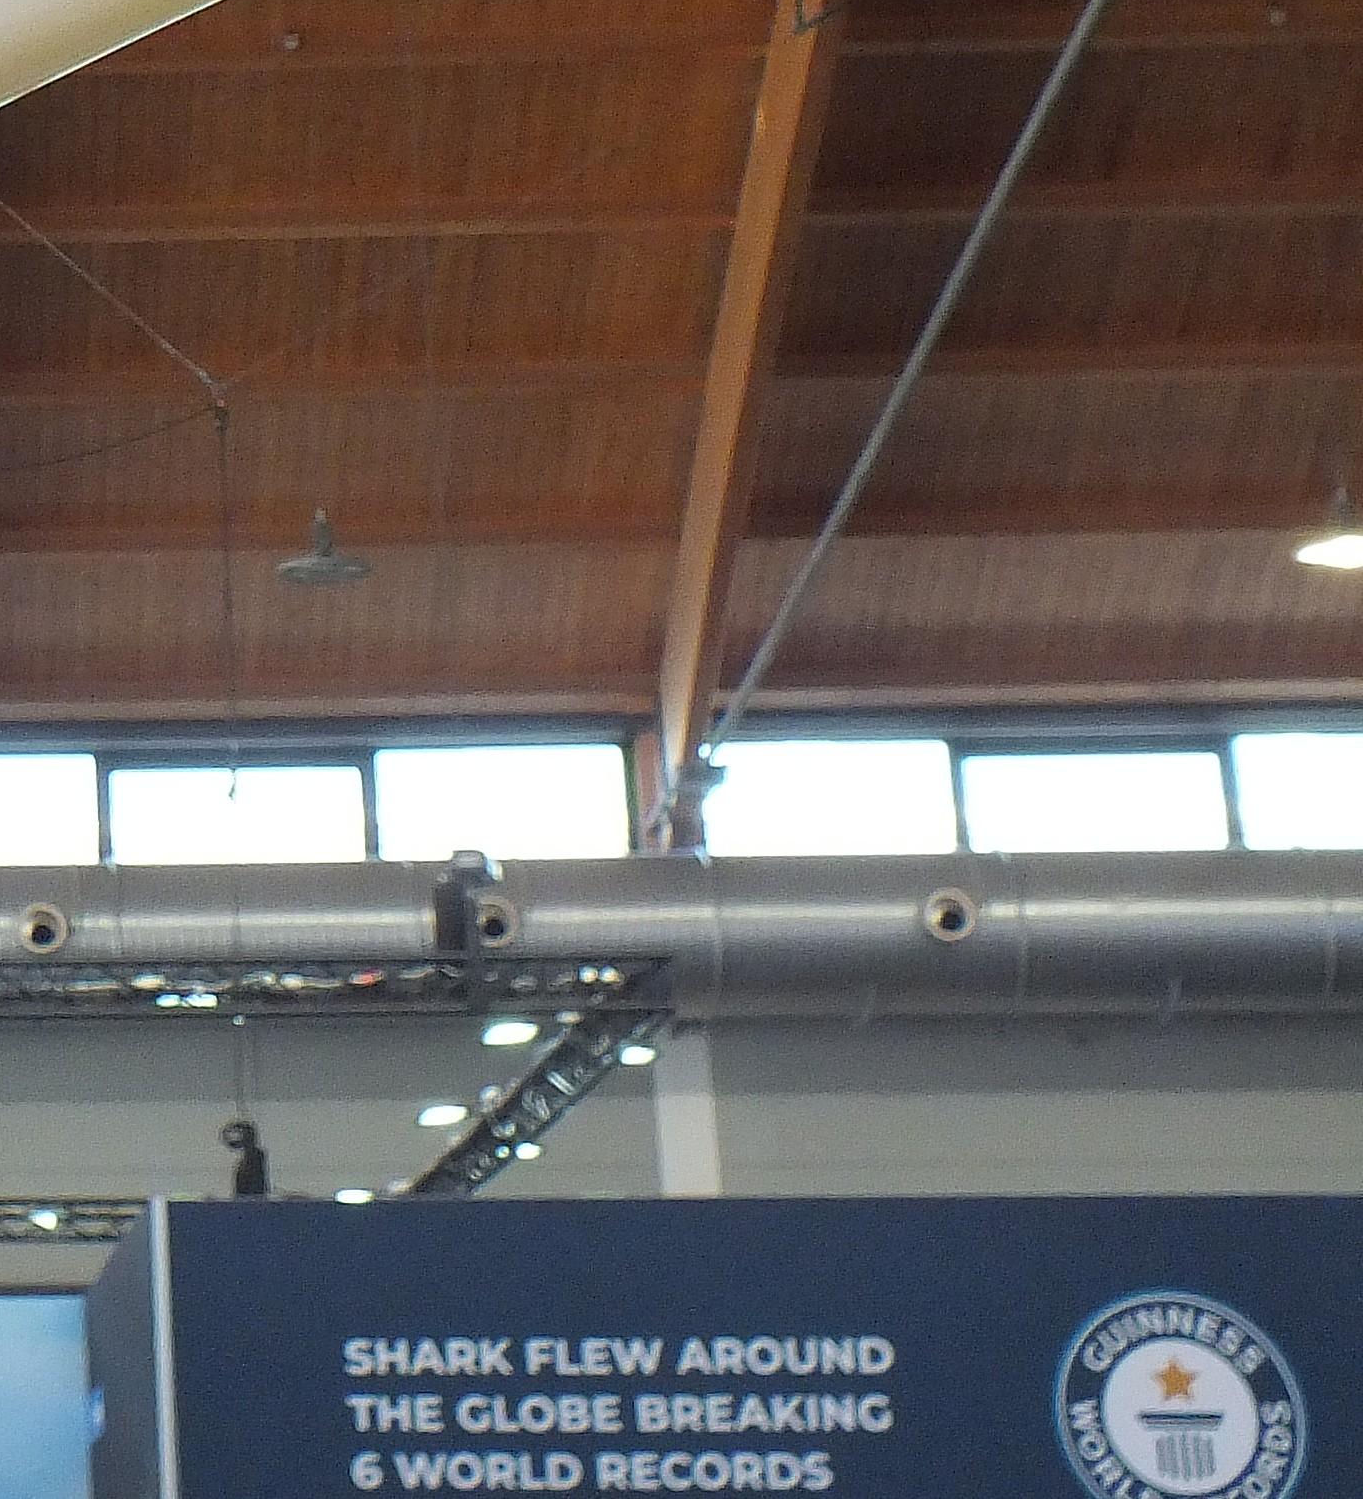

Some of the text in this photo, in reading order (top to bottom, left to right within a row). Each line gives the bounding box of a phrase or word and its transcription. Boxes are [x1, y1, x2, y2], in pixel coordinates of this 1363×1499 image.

[342, 1335, 896, 1377] SHARK FLEW AROUND
[344, 1393, 895, 1434] THE GLOBE BREAKING
[349, 1451, 834, 1491] 6 WORLD RECORDS
